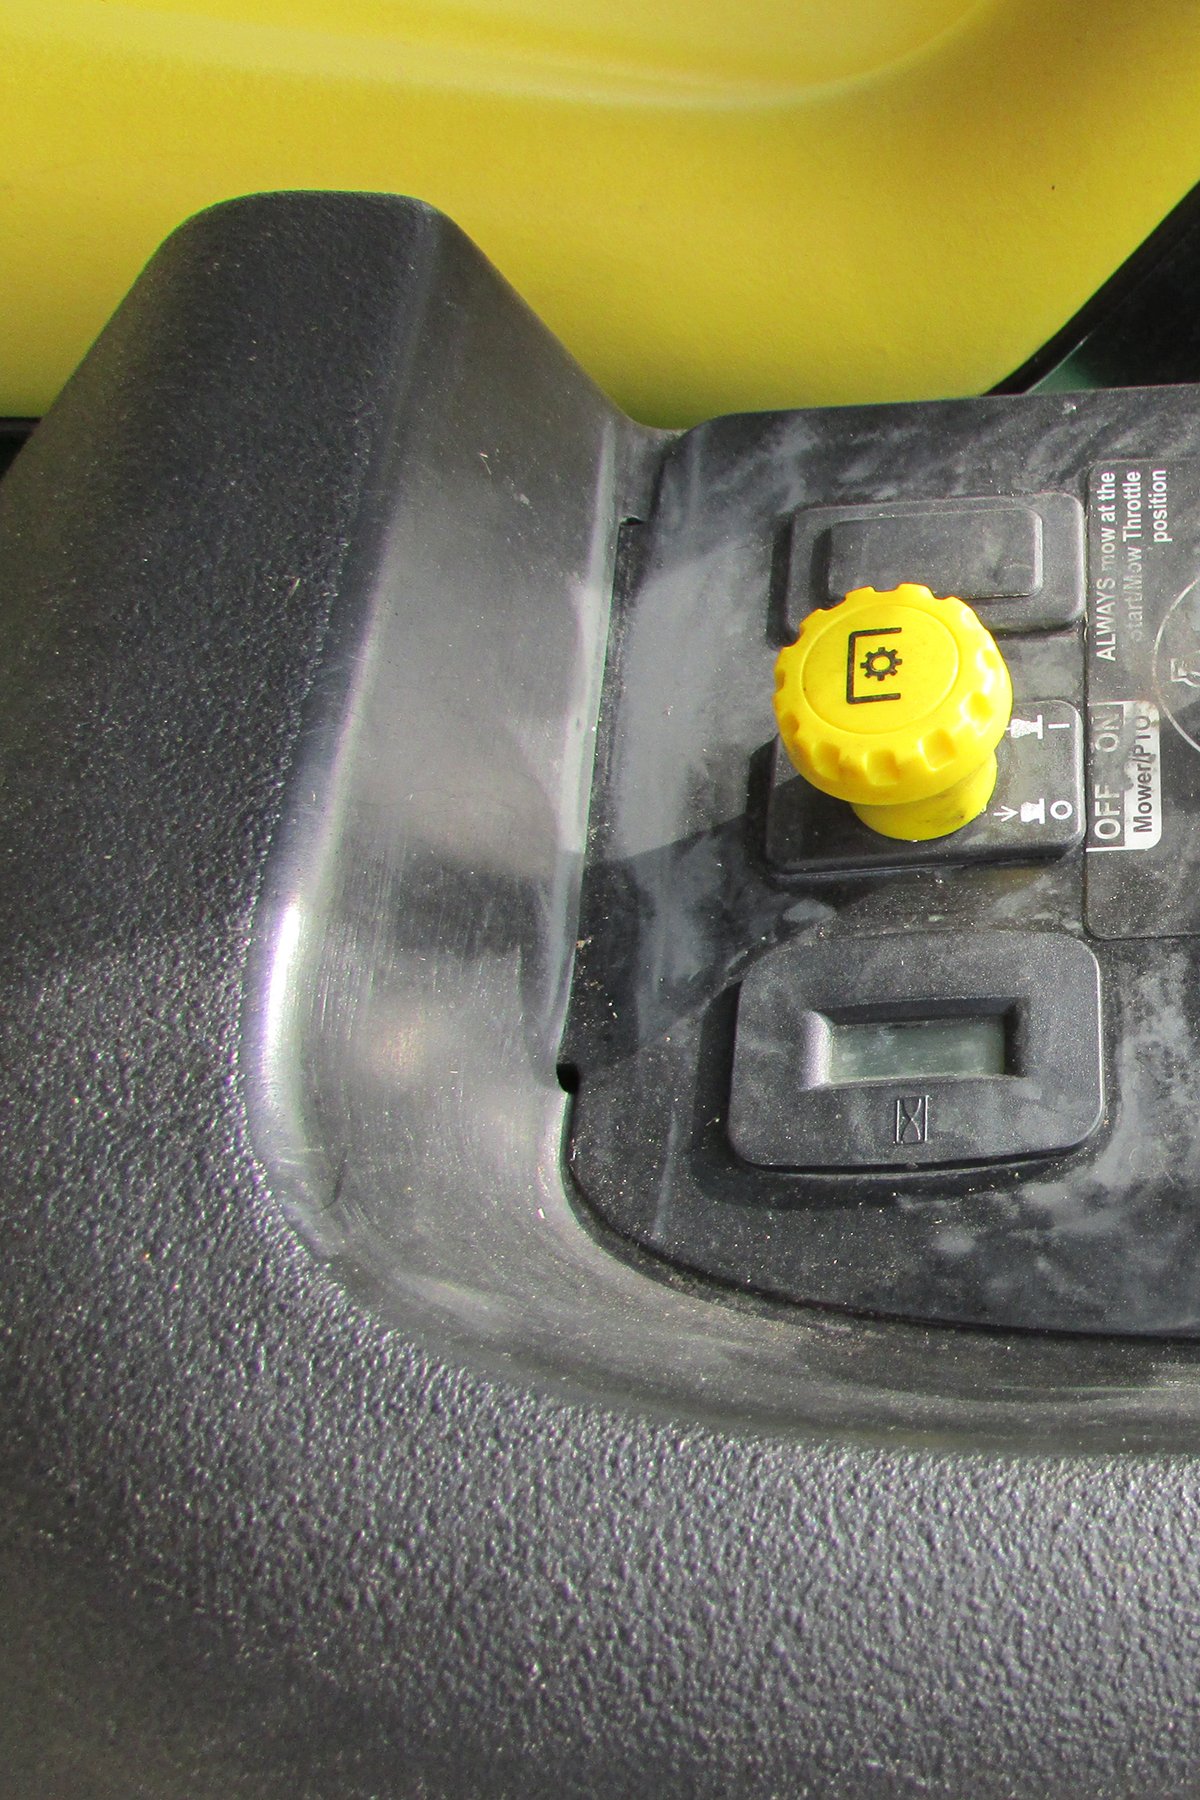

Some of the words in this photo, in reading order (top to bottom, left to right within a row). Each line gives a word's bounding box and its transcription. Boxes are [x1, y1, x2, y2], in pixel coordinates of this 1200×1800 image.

[1097, 472, 1116, 500] the
[1122, 471, 1142, 542] Throttle
[1148, 470, 1173, 542] position
[1098, 504, 1116, 522] at
[1101, 526, 1116, 571] mow
[1096, 578, 1116, 661] ALWAYS
[1092, 708, 1120, 752] ON
[1094, 784, 1121, 839] OFF
